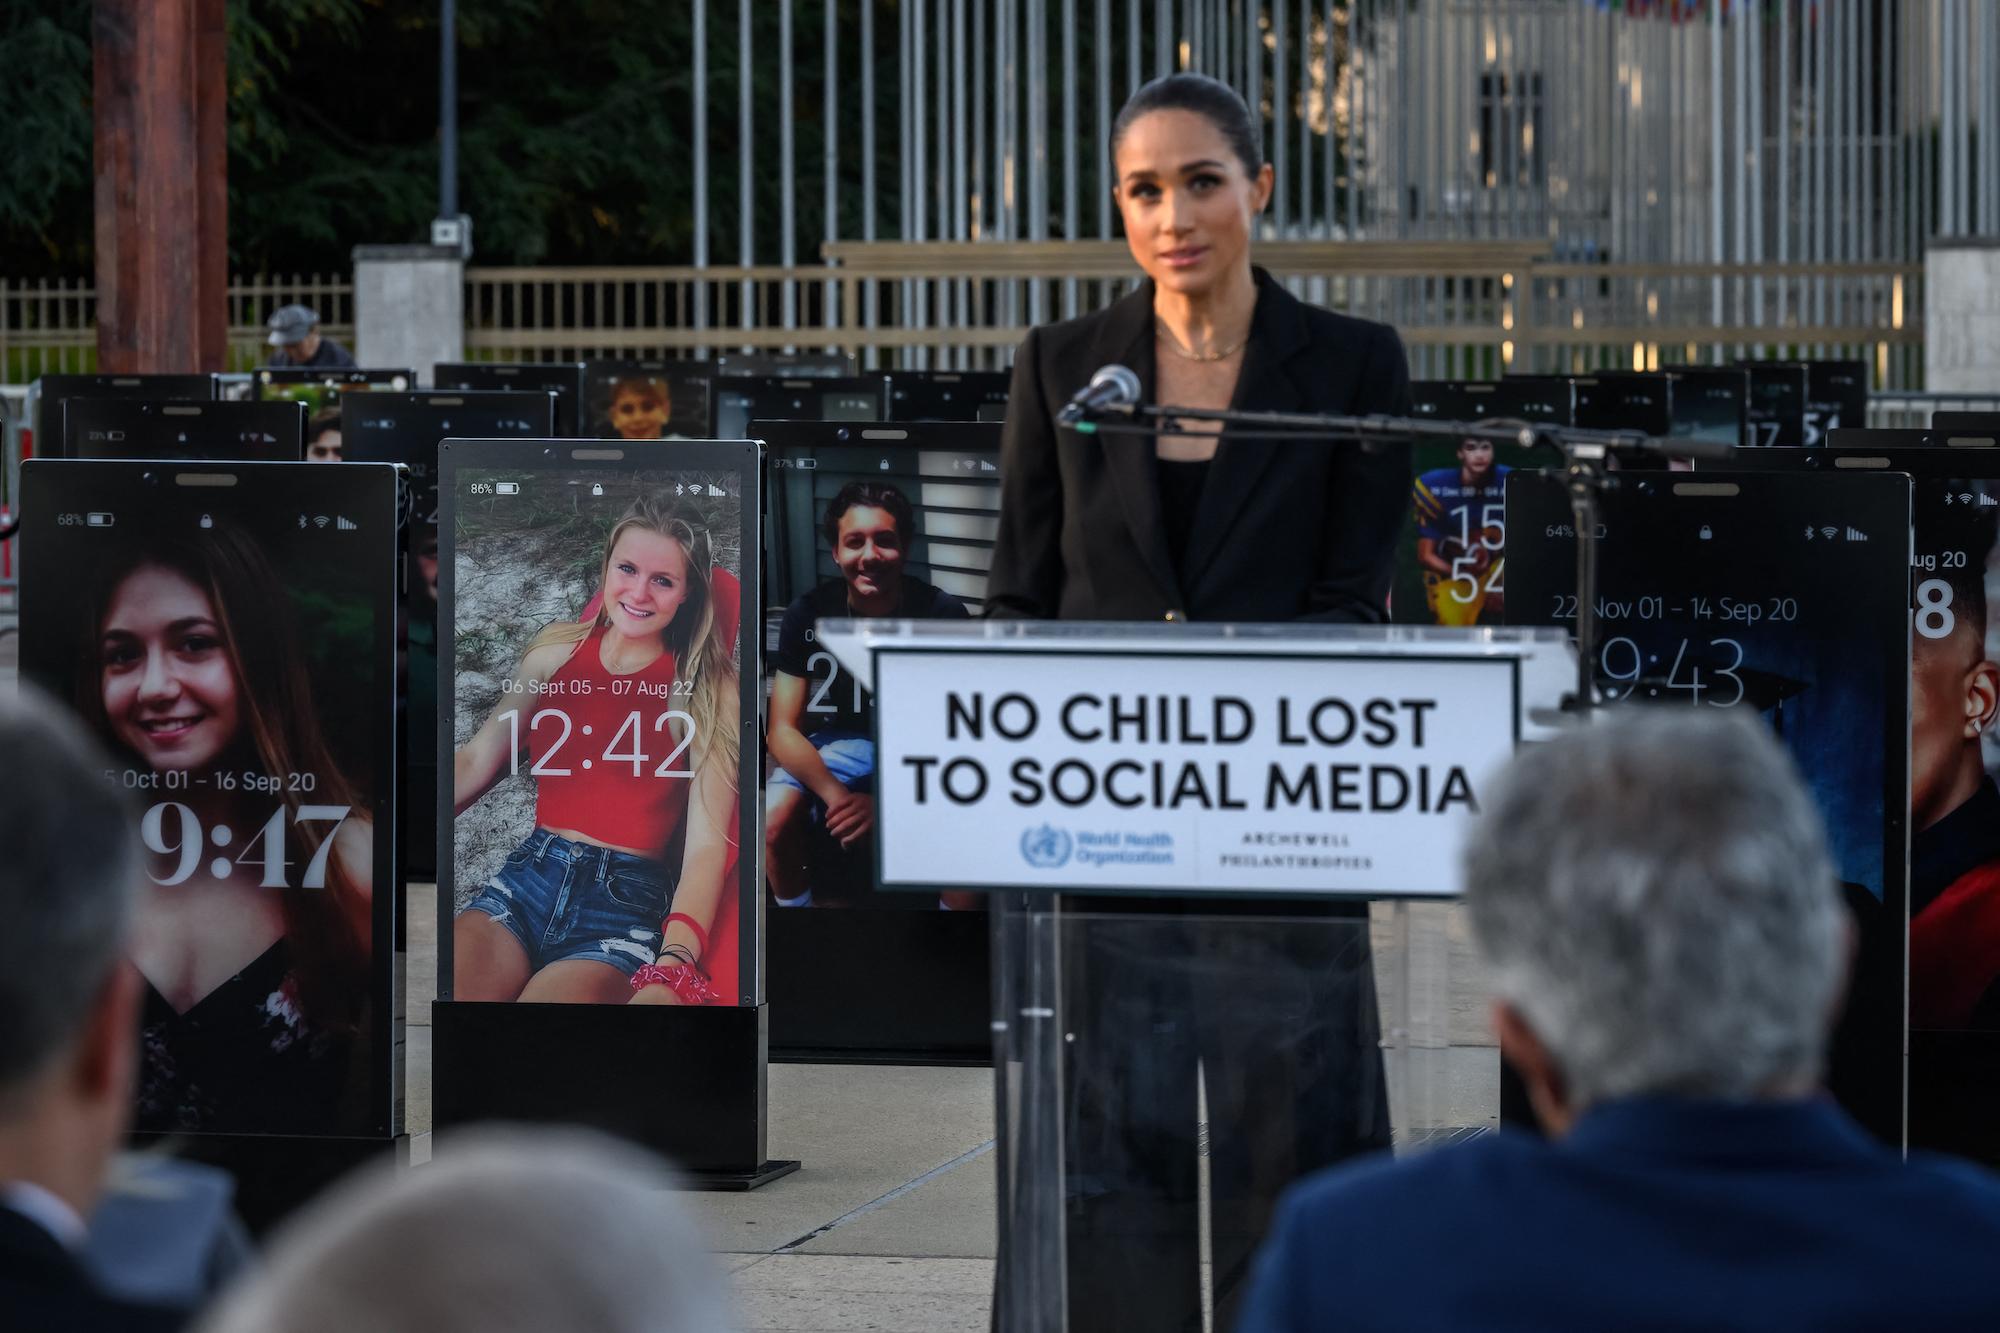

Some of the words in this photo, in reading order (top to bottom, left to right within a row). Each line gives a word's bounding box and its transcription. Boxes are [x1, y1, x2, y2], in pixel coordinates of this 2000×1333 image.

[774, 458, 794, 469] 37%
[470, 482, 493, 494] 86%
[57, 513, 84, 526] 68%
[1450, 503, 1505, 550] 15
[1545, 524, 1574, 537] 64%
[1914, 553, 1937, 572] ug
[1941, 550, 1967, 568] 20
[1551, 595, 1578, 618] 22
[1638, 596, 1662, 619] 01
[1690, 597, 1713, 620] 14
[1719, 597, 1762, 626] Sep
[1768, 598, 1798, 621] 20
[1914, 578, 1955, 639] 8
[1600, 636, 1744, 708] 9:43
[502, 678, 523, 694] 06
[528, 679, 566, 697] Sept
[570, 679, 592, 695] 05
[611, 680, 632, 695] 07
[636, 680, 668, 699] Aug
[673, 680, 693, 696] 22
[946, 691, 1040, 742] NO
[1060, 692, 1255, 744] CHILD
[1278, 696, 1437, 748] LOST
[497, 708, 696, 778] 12:42
[123, 769, 159, 789] Oct
[165, 769, 188, 789] 01
[213, 770, 236, 791] 16
[242, 771, 282, 796] Sep
[287, 772, 316, 792] 20
[901, 755, 990, 807] TO
[1009, 756, 1248, 810] SOCIAL
[1264, 761, 1481, 815] MEDIA
[141, 801, 352, 889] 9:47
[1076, 831, 1121, 847] World
[1125, 832, 1174, 848] Health
[1242, 831, 1349, 847] ARCHEWELL
[1076, 850, 1175, 868] Organization
[1220, 853, 1373, 870] PHILANTHROPIES
